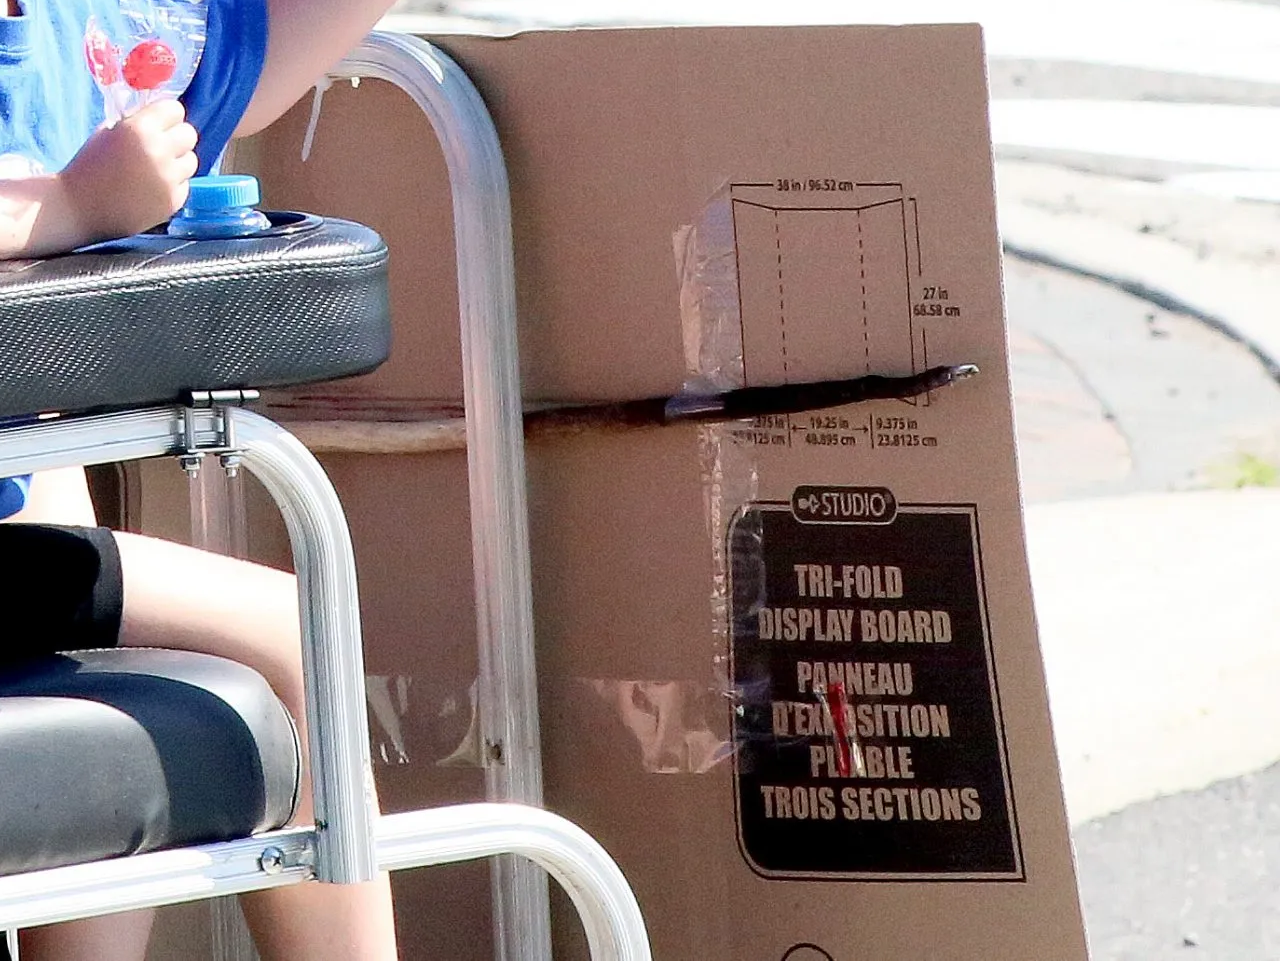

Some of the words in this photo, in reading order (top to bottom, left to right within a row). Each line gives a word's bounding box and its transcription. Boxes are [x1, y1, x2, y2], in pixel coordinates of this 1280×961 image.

[777, 179, 790, 191] 38
[791, 179, 801, 191] in
[808, 179, 836, 191] 96.52
[838, 181, 854, 191] cm
[923, 287, 936, 300] 27
[938, 286, 949, 300] in
[913, 303, 942, 316] 68.58
[944, 306, 960, 317] cm
[810, 416, 837, 429] 19.25
[839, 417, 849, 429] in
[876, 417, 905, 429] 9.375
[907, 417, 918, 429] in
[771, 435, 786, 445] cm
[840, 436, 856, 445] cm
[877, 434, 920, 446] 23.8125
[922, 436, 938, 446] cm
[821, 492, 886, 516] STUDIO
[794, 564, 904, 599] TRI-FOLD
[759, 607, 854, 643] DISPLAY
[861, 610, 953, 644] BOARD
[797, 661, 914, 696] PANNEAU
[809, 744, 915, 779] PLABLE
[760, 785, 836, 821] TROIS
[841, 787, 982, 822] SECTIONS
